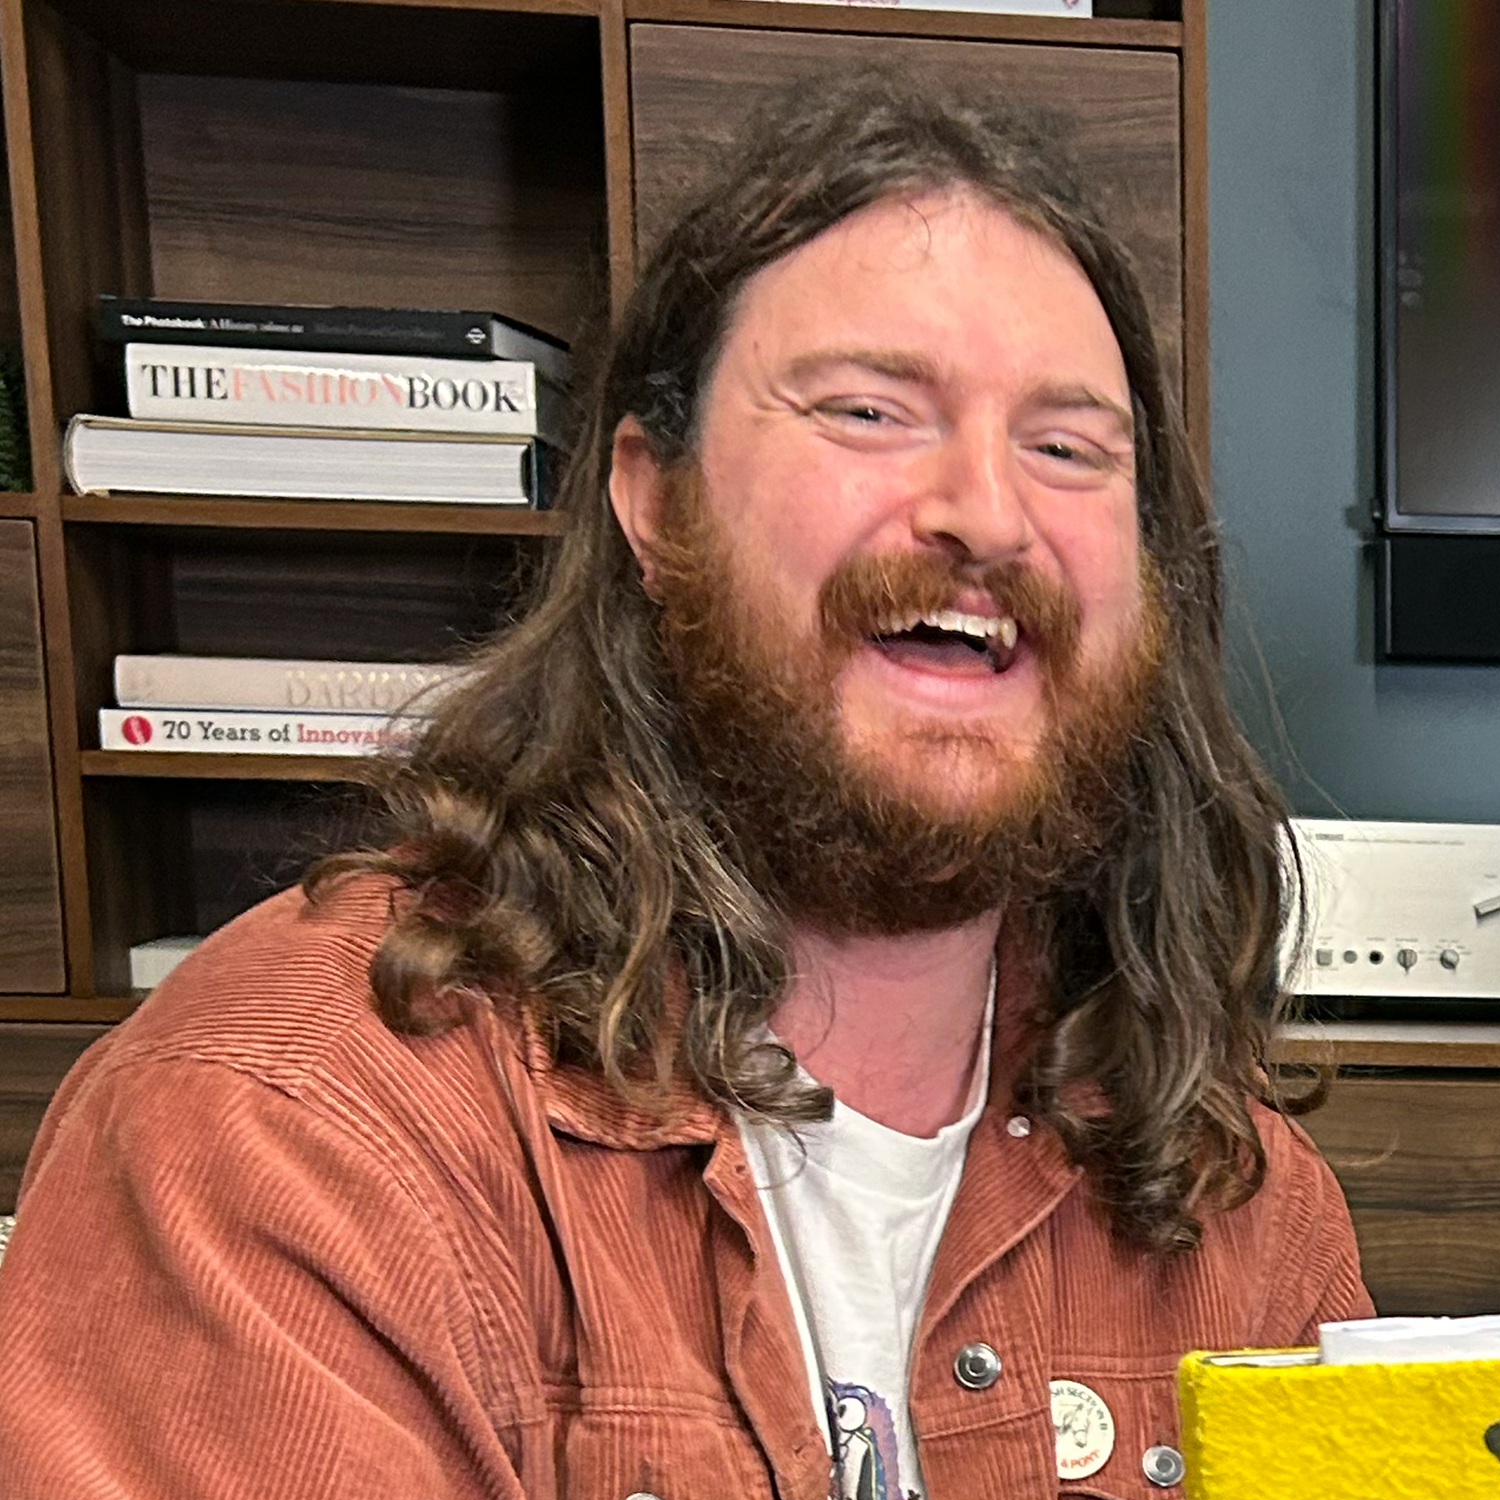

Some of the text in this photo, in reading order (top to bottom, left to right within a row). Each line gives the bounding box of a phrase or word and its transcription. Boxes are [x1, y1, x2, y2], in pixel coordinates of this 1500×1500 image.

[163, 720, 192, 740] 70
[198, 720, 261, 742] Years
[268, 723, 292, 743] of
